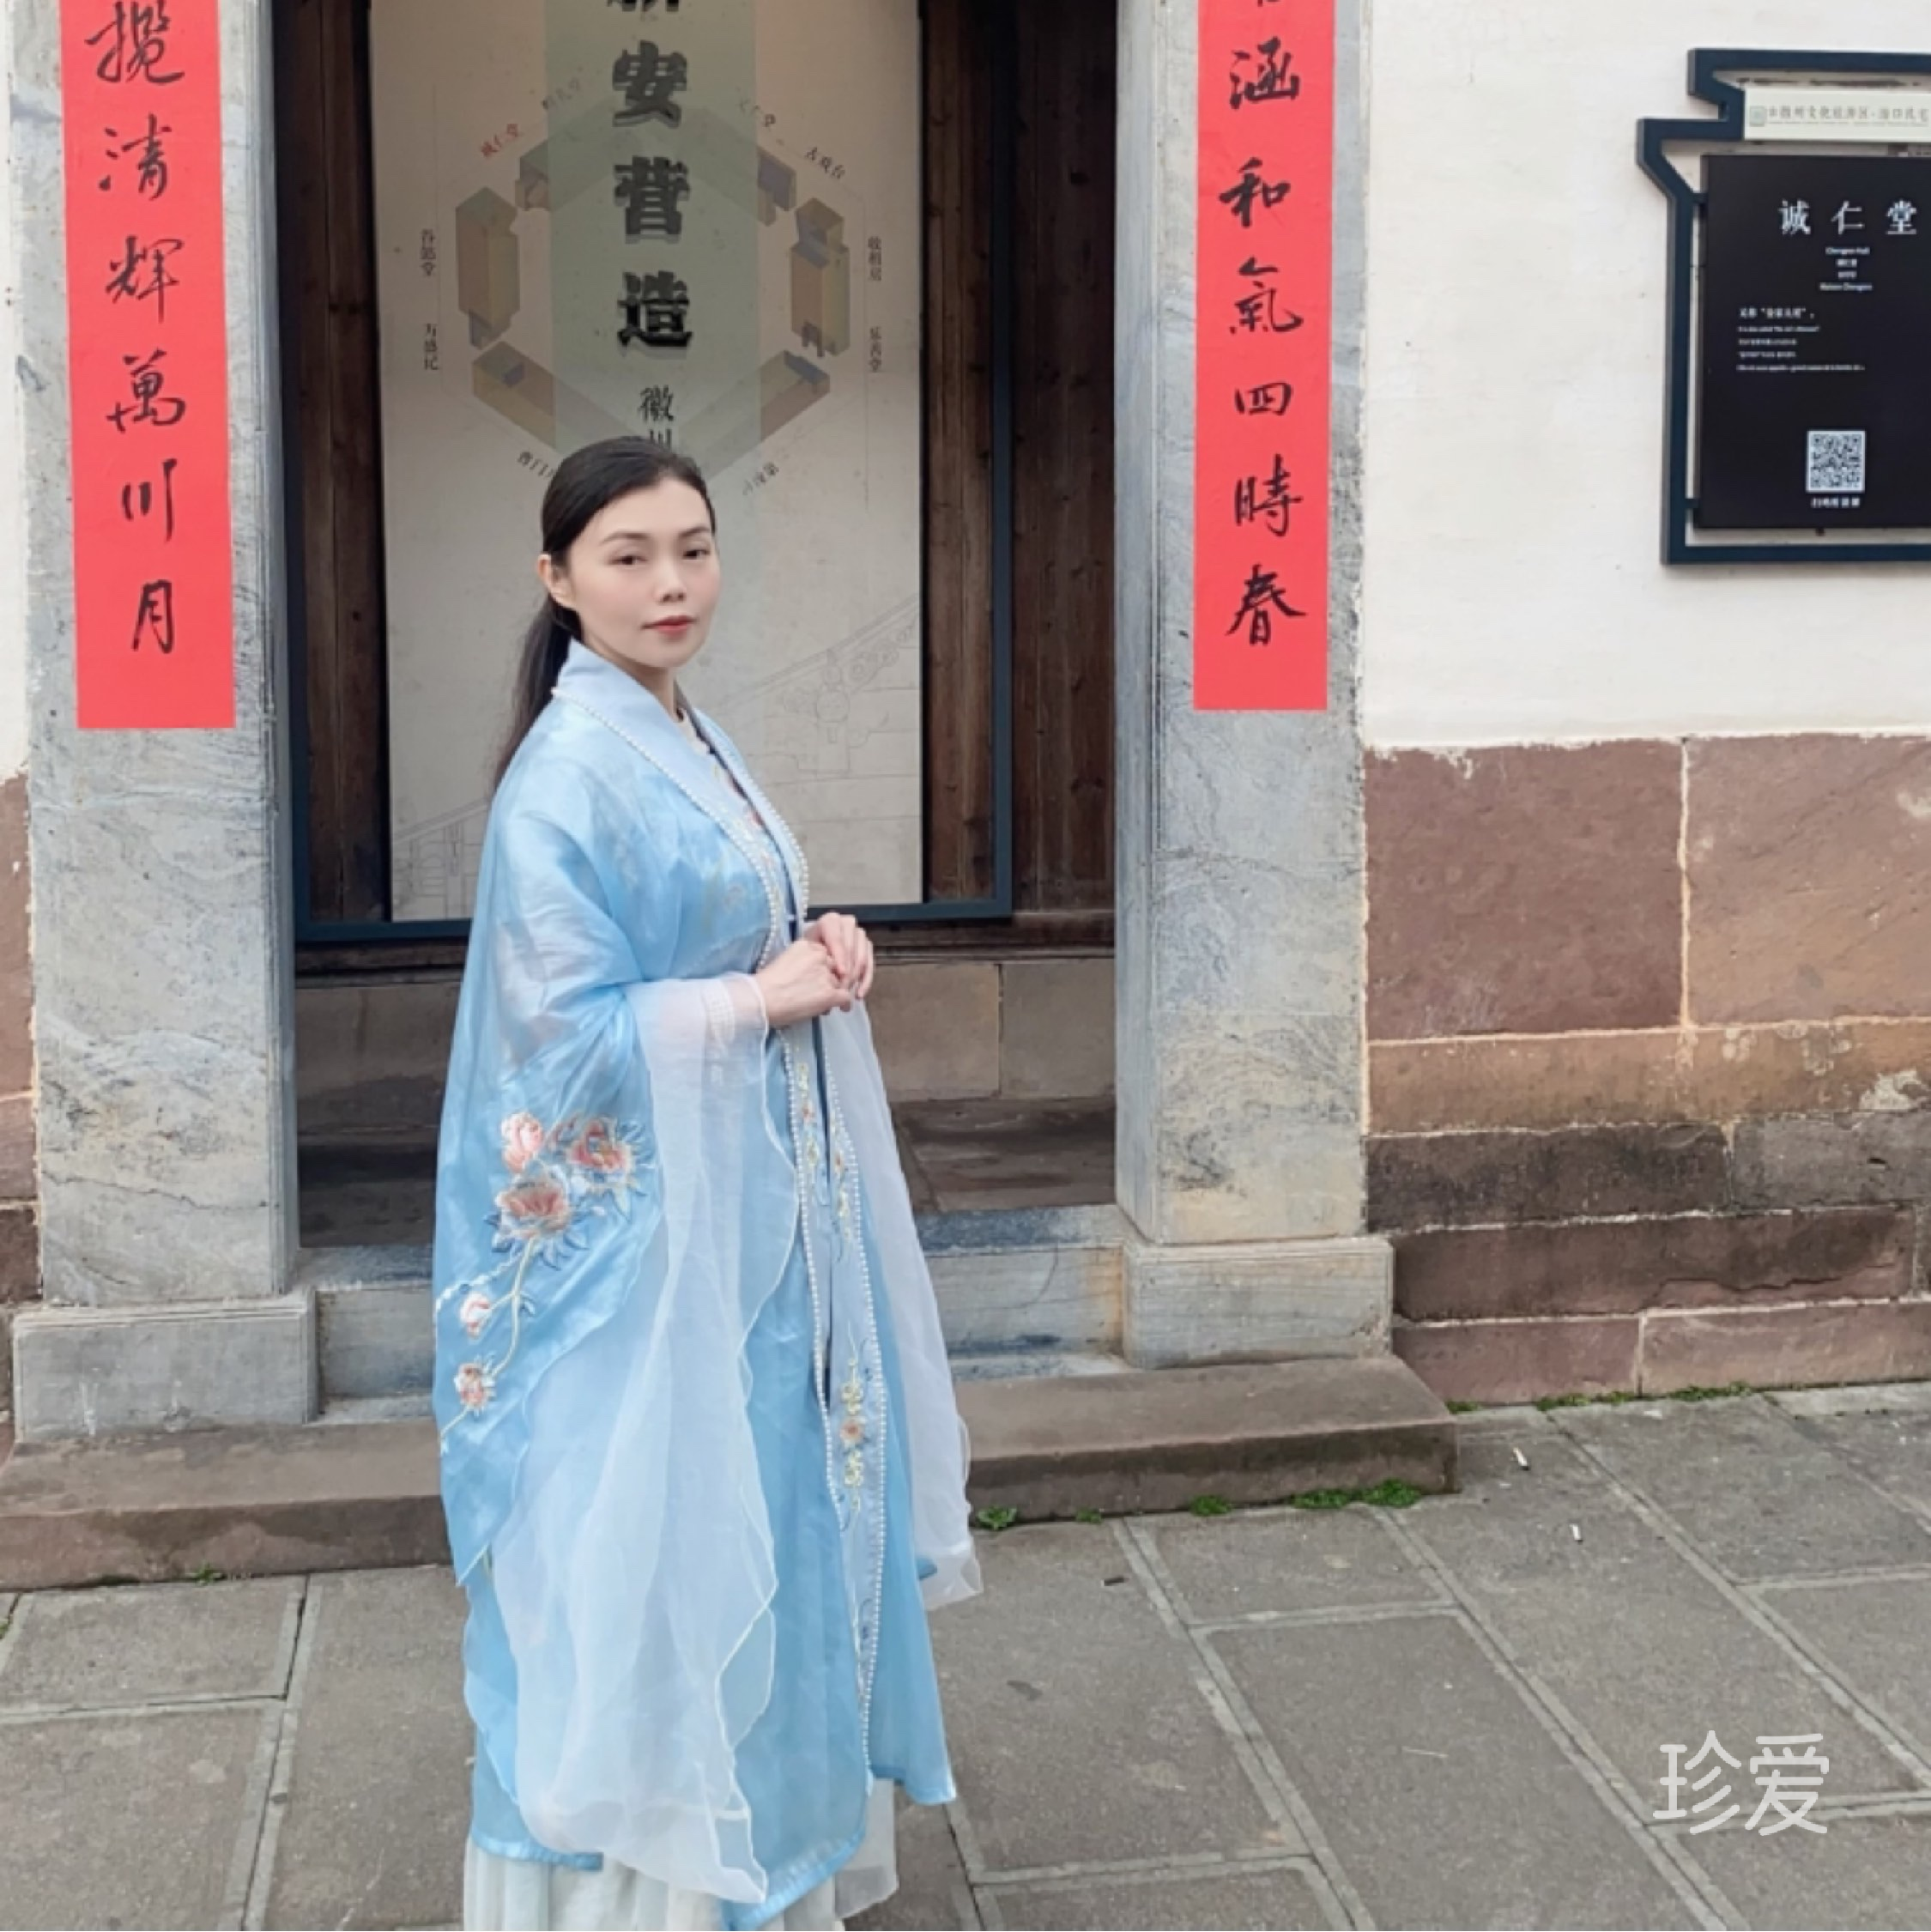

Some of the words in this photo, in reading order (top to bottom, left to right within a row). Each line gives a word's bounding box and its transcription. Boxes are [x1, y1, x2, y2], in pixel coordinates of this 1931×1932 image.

[608, 0, 692, 350] 安营造
[1778, 198, 1917, 235] 诚仁堂
